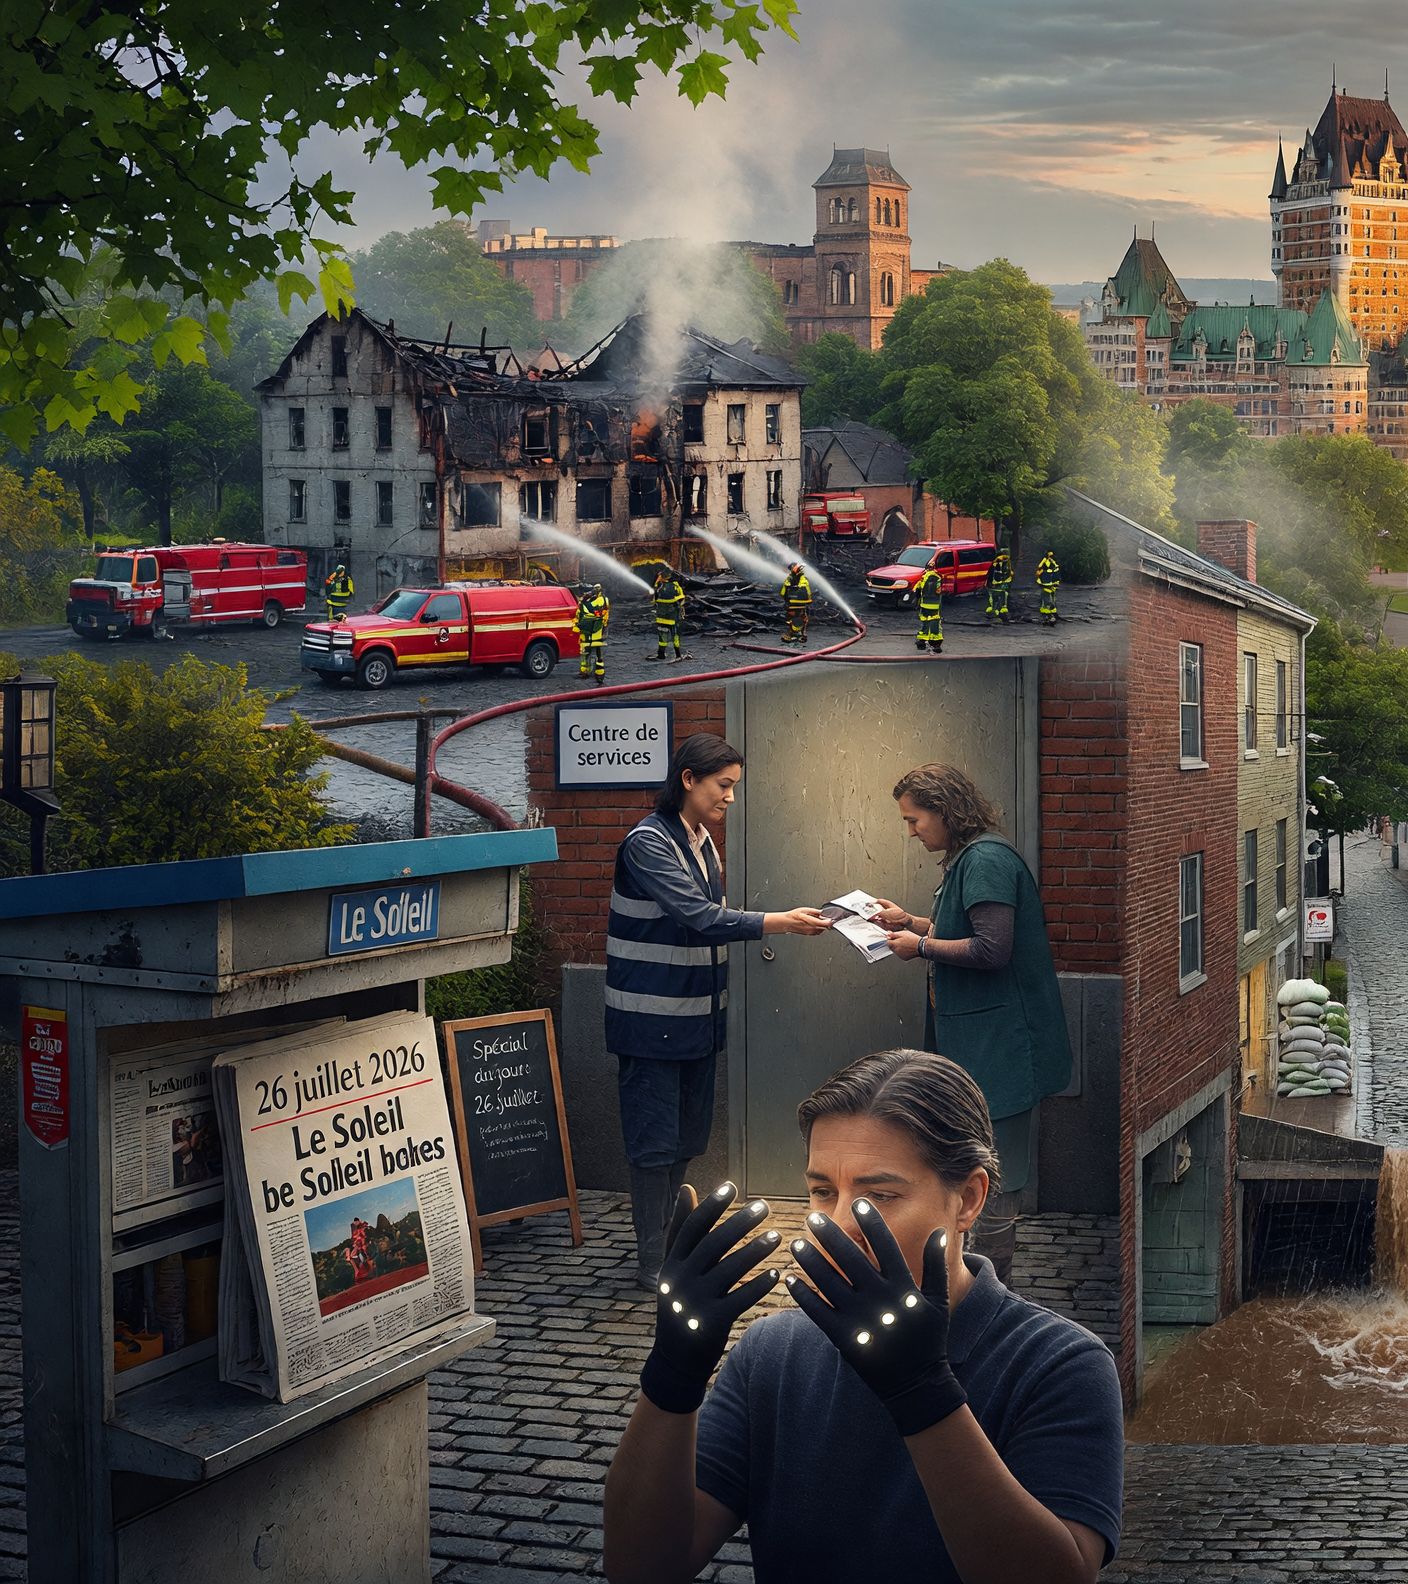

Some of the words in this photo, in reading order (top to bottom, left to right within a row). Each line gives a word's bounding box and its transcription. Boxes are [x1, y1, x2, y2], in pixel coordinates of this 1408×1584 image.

[568, 724, 629, 742] Centre
[636, 723, 659, 741] de
[577, 748, 651, 765] services
[340, 902, 366, 944] Le
[472, 1031, 529, 1062] Spécial
[255, 1074, 288, 1116] 26
[294, 1059, 365, 1114] juillet
[368, 1041, 426, 1085] 2026
[474, 1094, 494, 1115] 26
[291, 1125, 327, 1161] Le
[332, 1095, 405, 1149] Soleil
[261, 1180, 296, 1214] be
